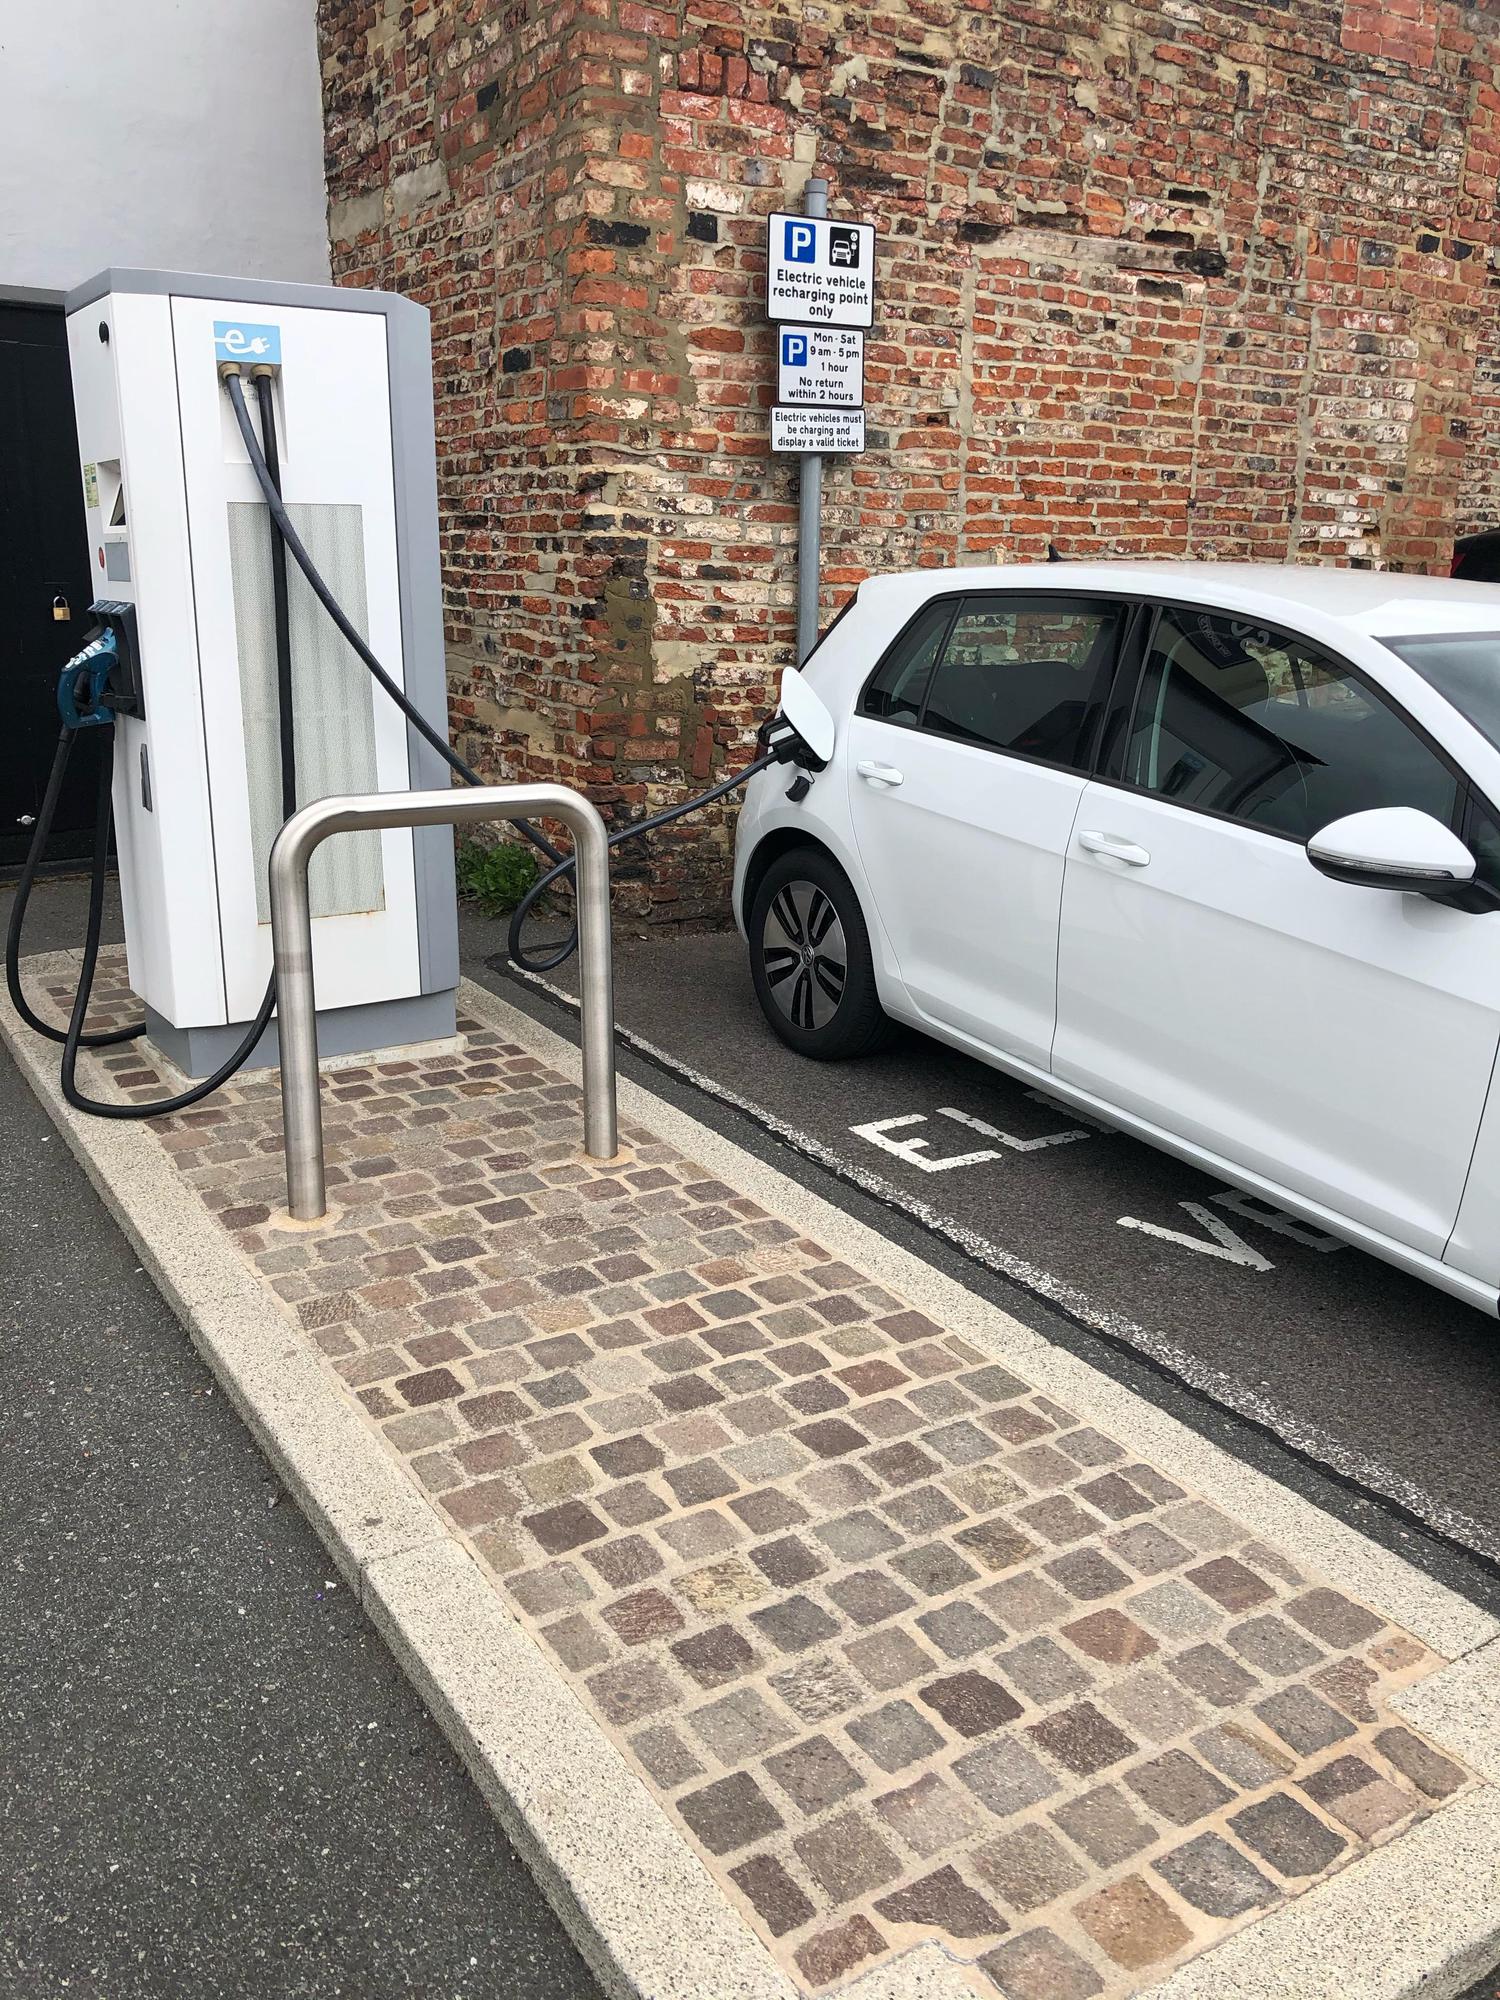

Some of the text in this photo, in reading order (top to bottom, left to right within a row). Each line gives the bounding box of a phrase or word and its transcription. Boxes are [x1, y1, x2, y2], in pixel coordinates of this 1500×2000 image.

[792, 226, 811, 258] P
[777, 269, 866, 289] Electric vehicle
[773, 286, 868, 305] recharging point
[809, 305, 833, 319] only
[813, 332, 833, 343] Mon
[840, 334, 856, 345] Sat
[788, 338, 804, 363] P
[821, 362, 848, 372] 1 hour
[799, 377, 844, 388] No return
[788, 389, 853, 401] within 2 hours
[775, 412, 862, 423] Electric vehicles must
[787, 424, 850, 436] be charging and
[778, 436, 806, 448] display
[816, 437, 834, 447] valid
[837, 438, 859, 447] ticket
